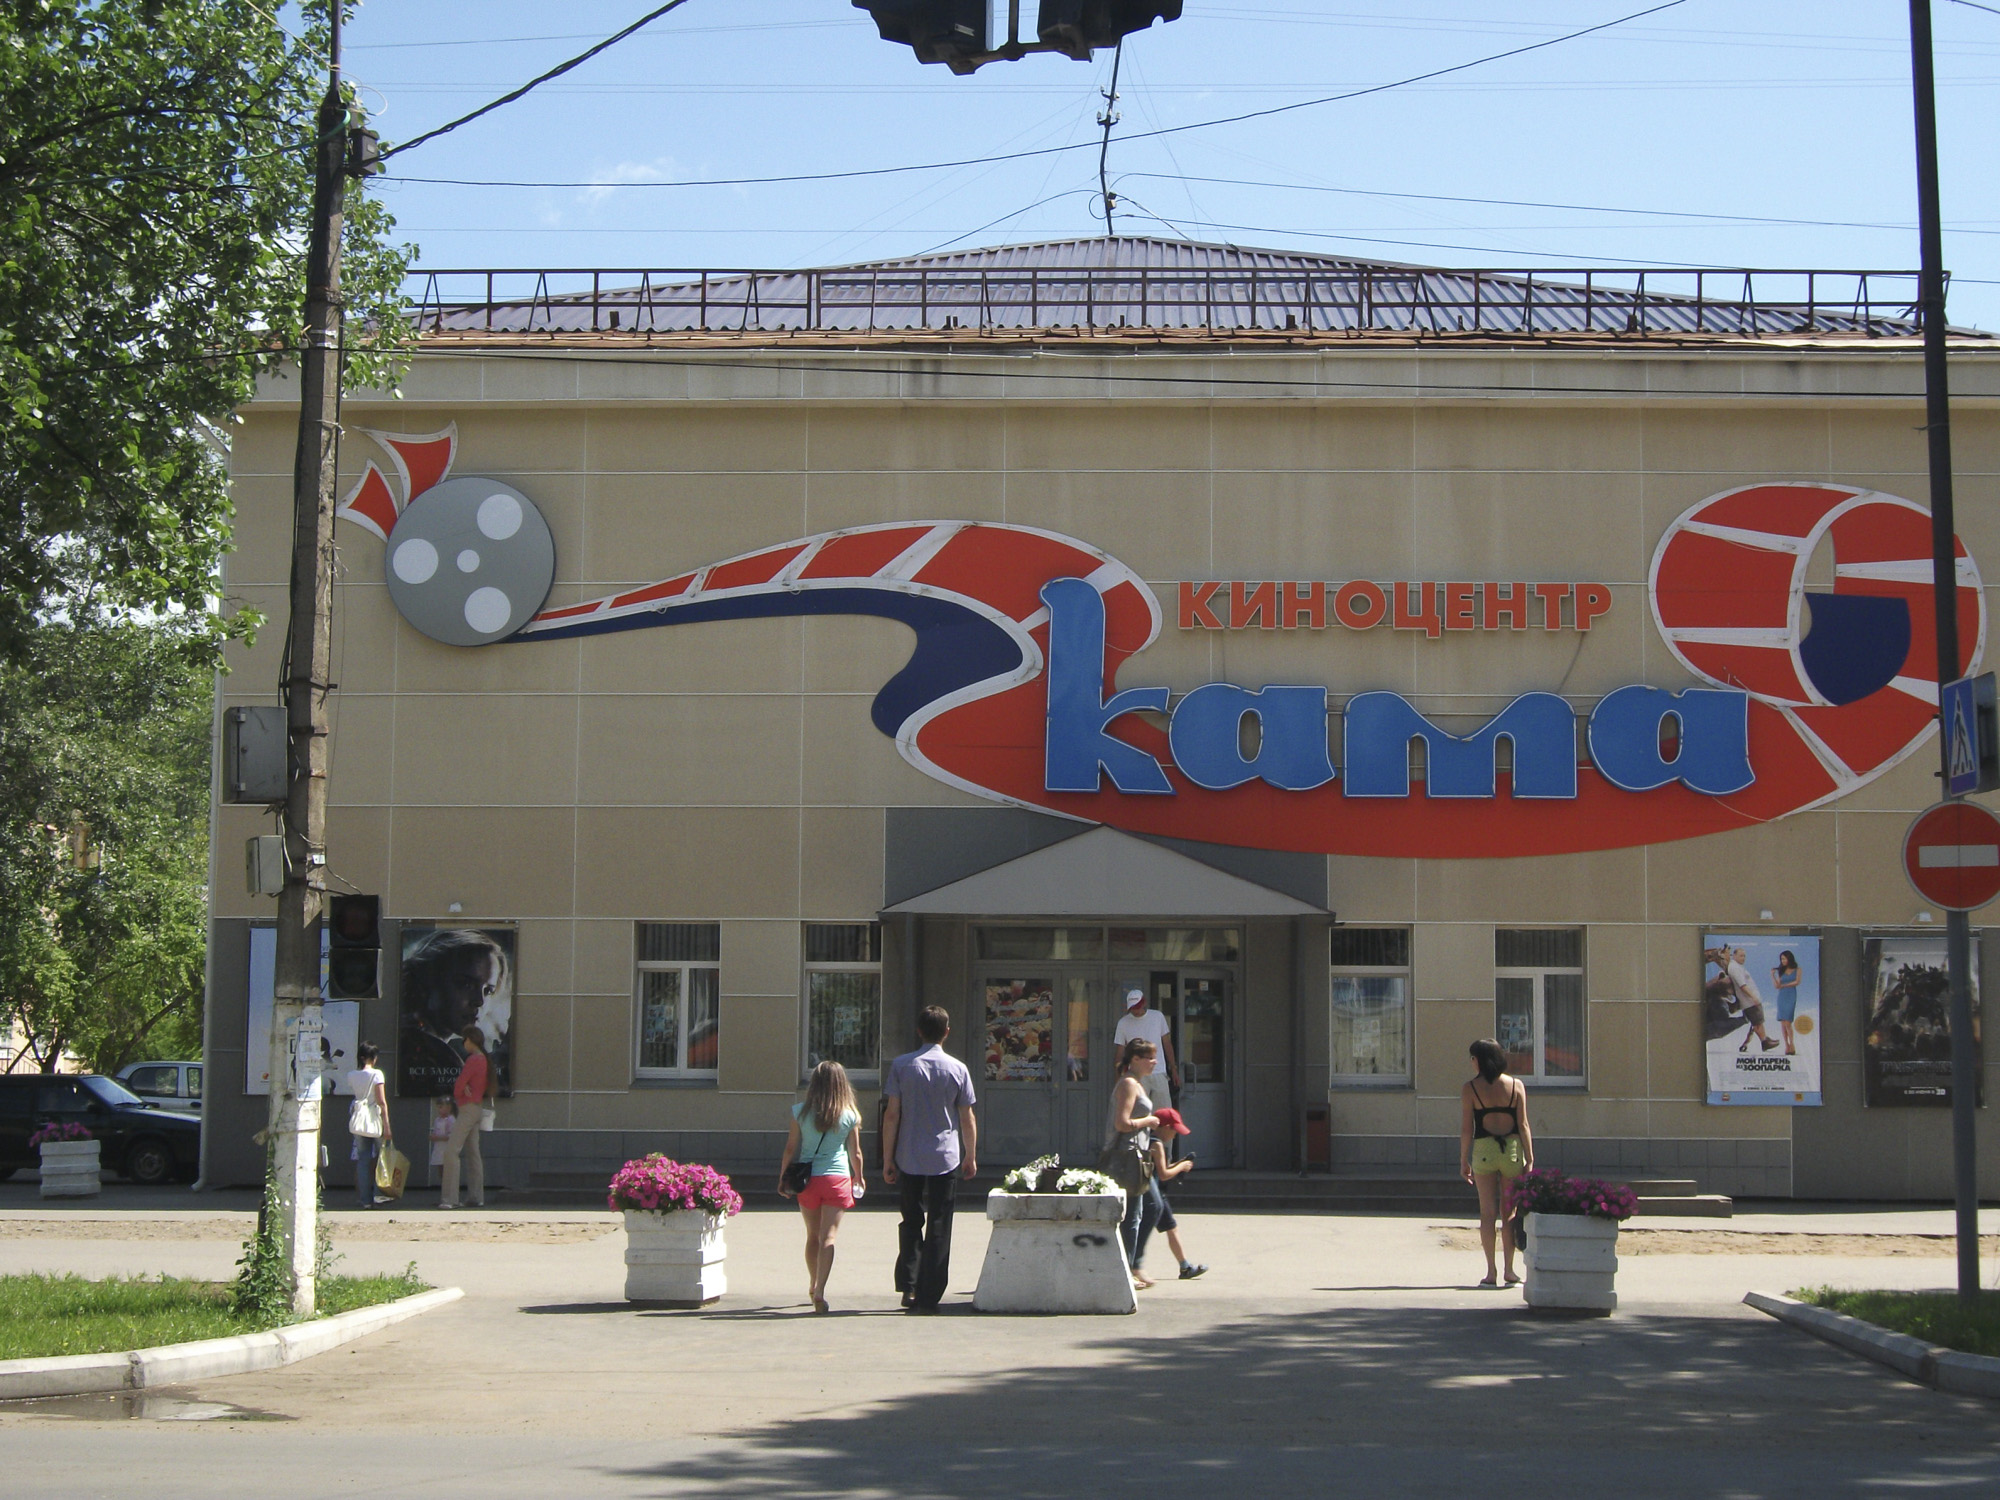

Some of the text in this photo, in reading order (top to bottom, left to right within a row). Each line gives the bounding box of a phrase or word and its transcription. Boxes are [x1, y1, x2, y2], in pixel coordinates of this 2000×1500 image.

[1178, 579, 1613, 639] КИНОЦЕНТР
[1736, 1056, 1791, 1065] МОЙ ПАРЕНЬ
[1742, 1064, 1792, 1072] ЗООПАРКА
